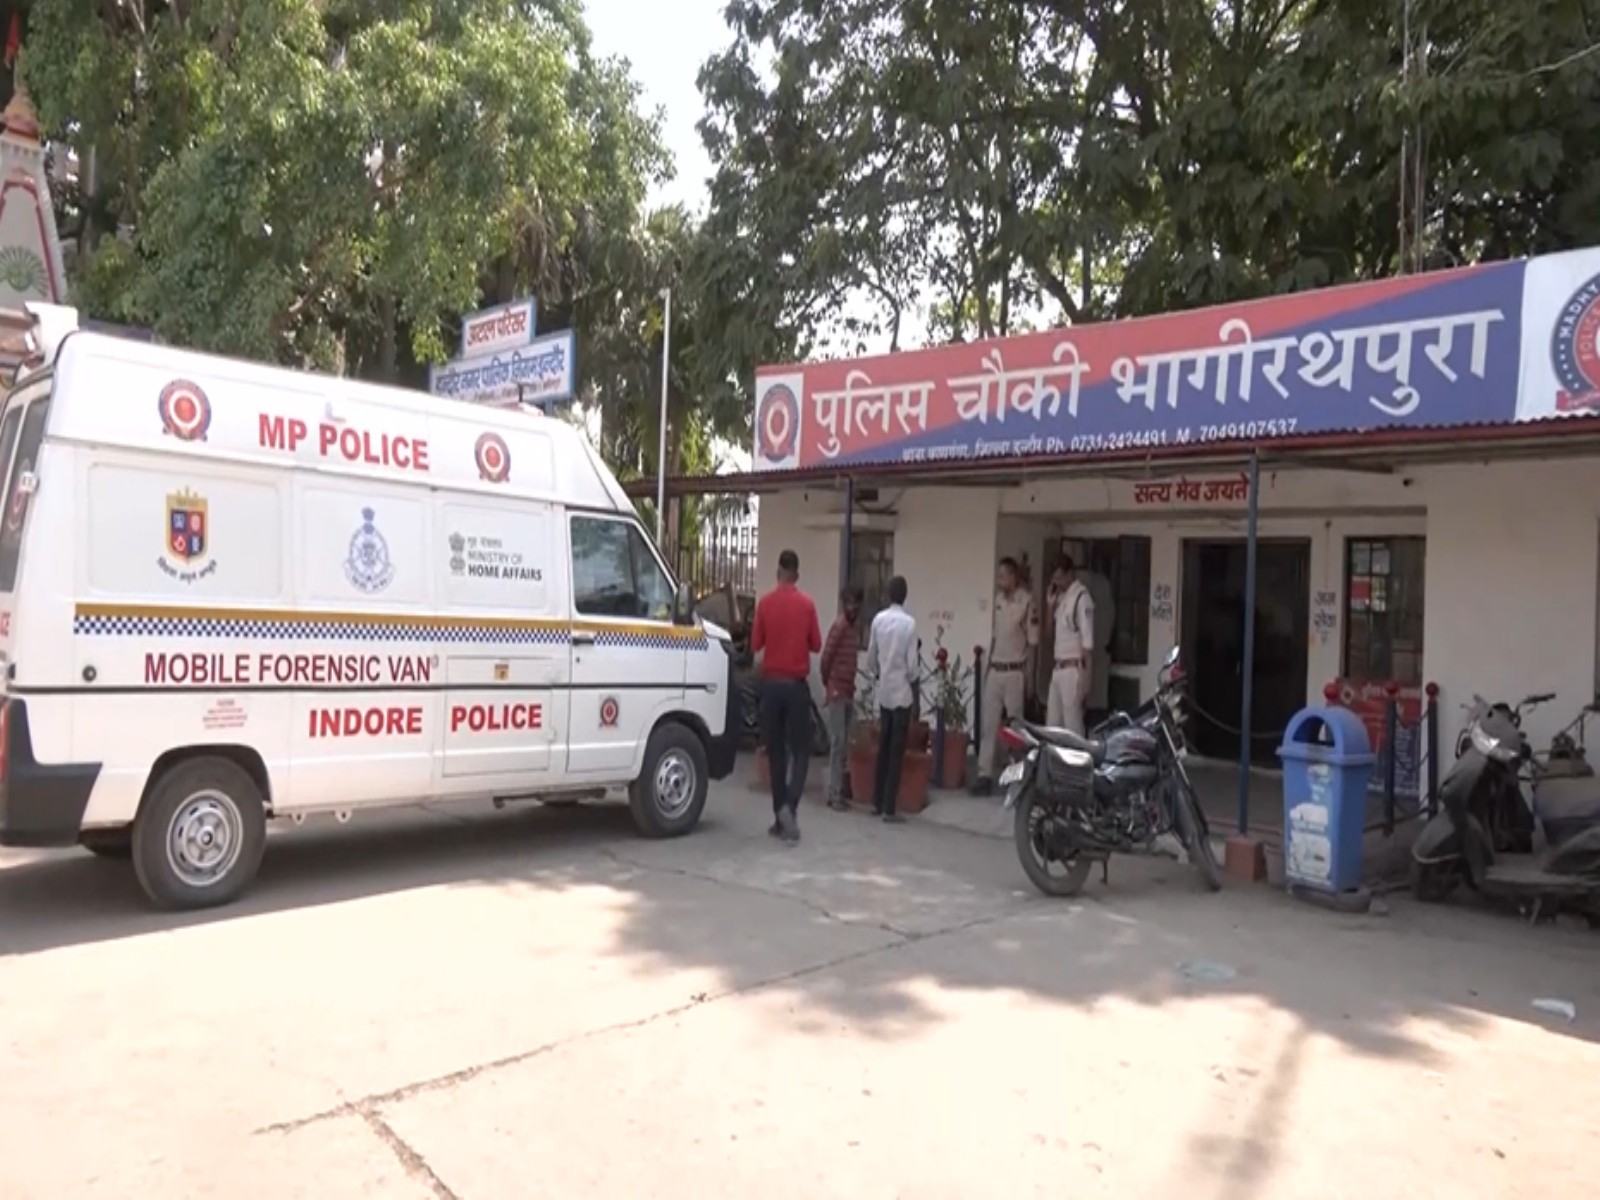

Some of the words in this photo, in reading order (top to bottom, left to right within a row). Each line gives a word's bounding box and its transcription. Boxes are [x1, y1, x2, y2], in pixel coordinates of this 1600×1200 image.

[467, 319, 496, 346] अटल
[497, 307, 527, 336] परिसर
[1559, 282, 1599, 338] MADHY
[811, 370, 936, 458] पुलिस
[948, 342, 1090, 425] चौकी
[1111, 308, 1505, 416] भागीरथपुरा
[259, 413, 307, 451] MP
[319, 423, 429, 470] POLICE
[1134, 481, 1172, 504] सत्य
[1175, 474, 1202, 501] मेव
[1203, 472, 1250, 501] जयते
[468, 550, 509, 564] MINISTRY
[510, 552, 523, 565] OF
[468, 563, 499, 579] HOME
[501, 566, 542, 581] AFFAIRS
[144, 652, 251, 683] MOBILE
[258, 653, 381, 682] FORENSIC
[388, 655, 431, 682] VAN
[308, 707, 423, 738] INDORE
[451, 704, 543, 732] POLICE
